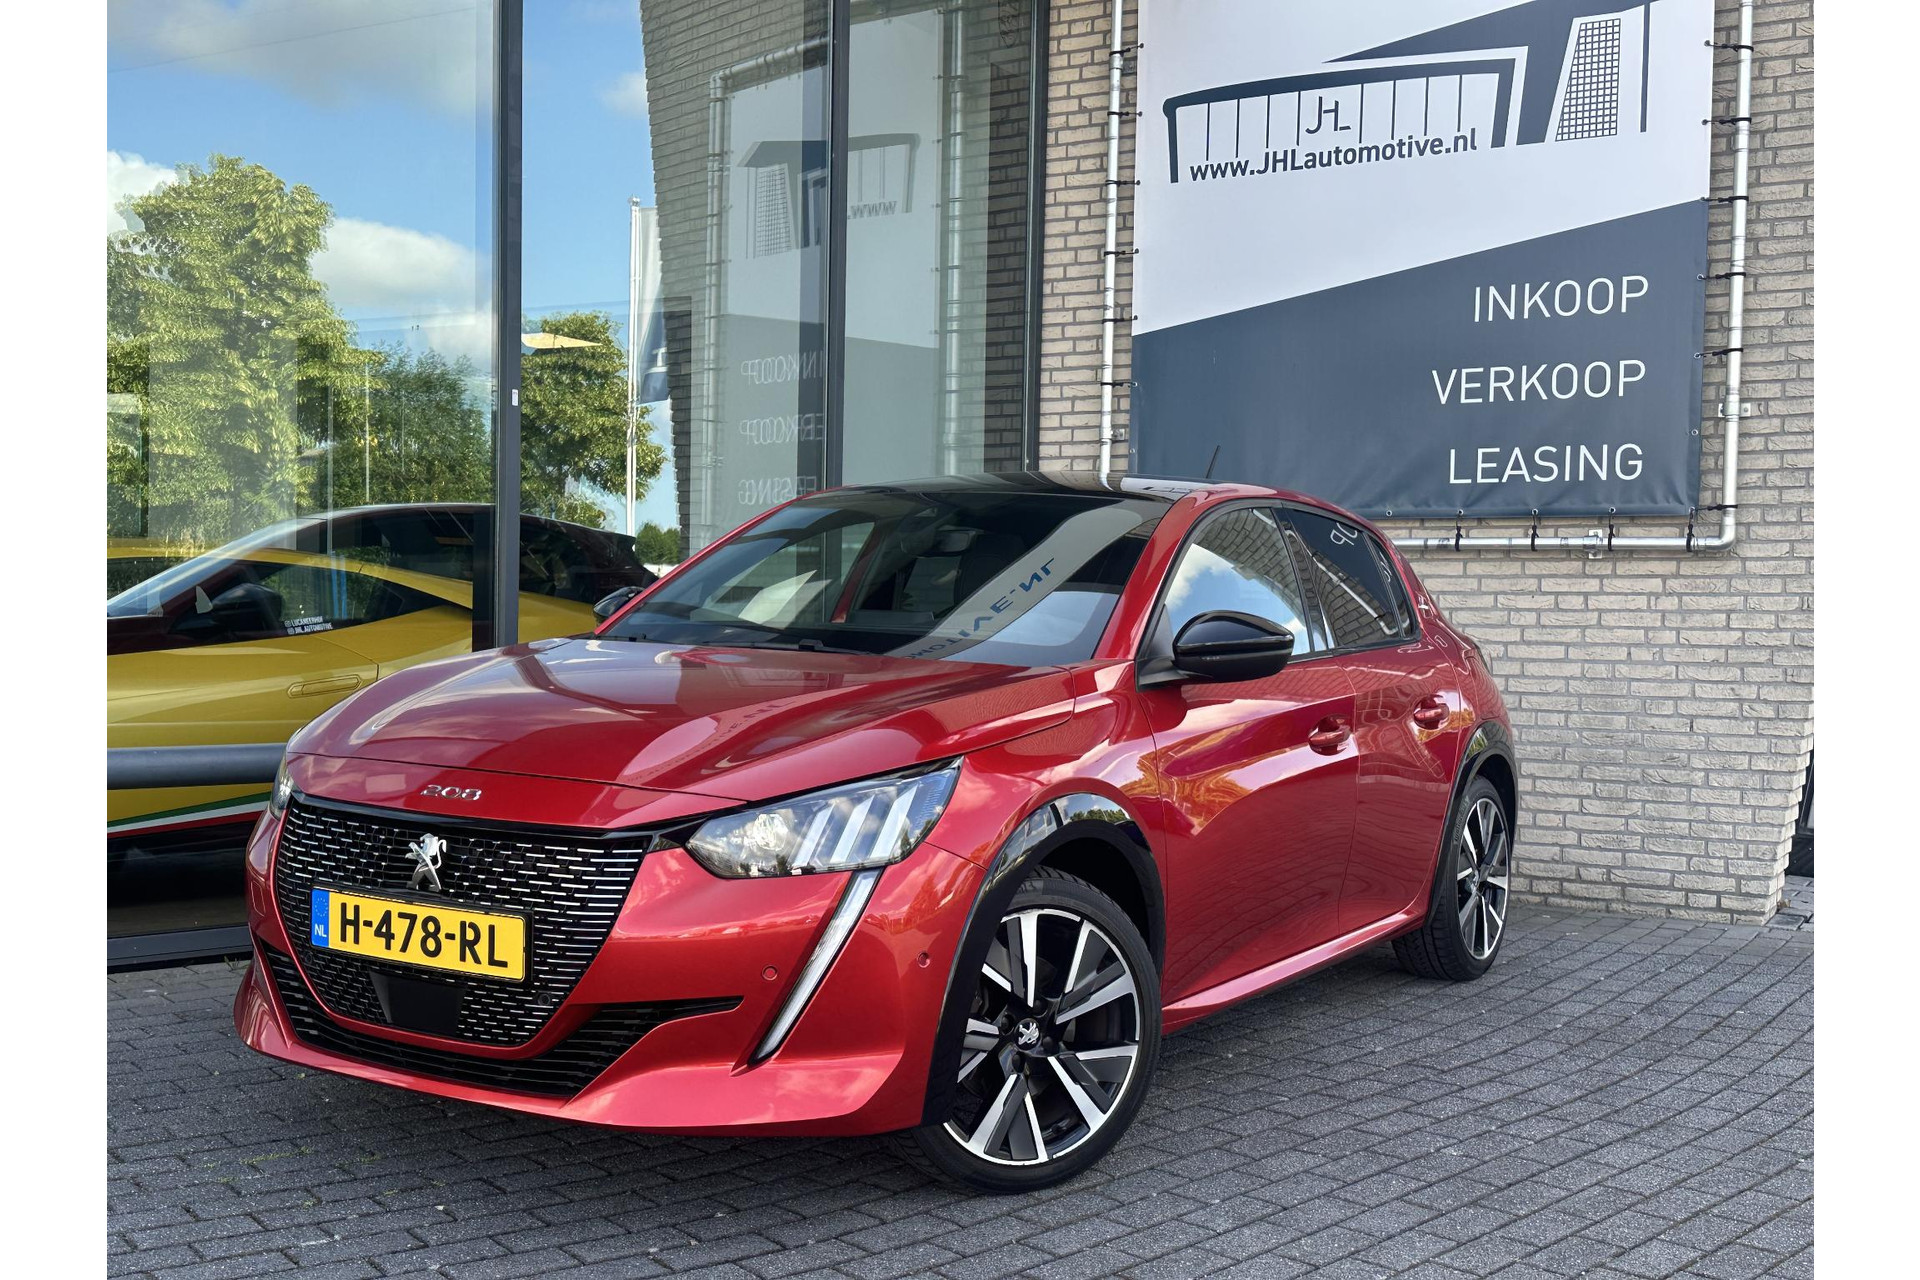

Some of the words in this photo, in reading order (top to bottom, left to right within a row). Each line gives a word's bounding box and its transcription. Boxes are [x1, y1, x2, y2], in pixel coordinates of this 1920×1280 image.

[1305, 96, 1352, 135] JHL
[1189, 127, 1478, 182] www.JHLautomotive.nl
[1473, 275, 1650, 323] INKOOP
[1431, 359, 1647, 405] VERKOOP
[1449, 443, 1644, 484] LEASING
[420, 784, 483, 801] 208
[314, 922, 328, 938] NL
[339, 901, 509, 969] H-478-RL
